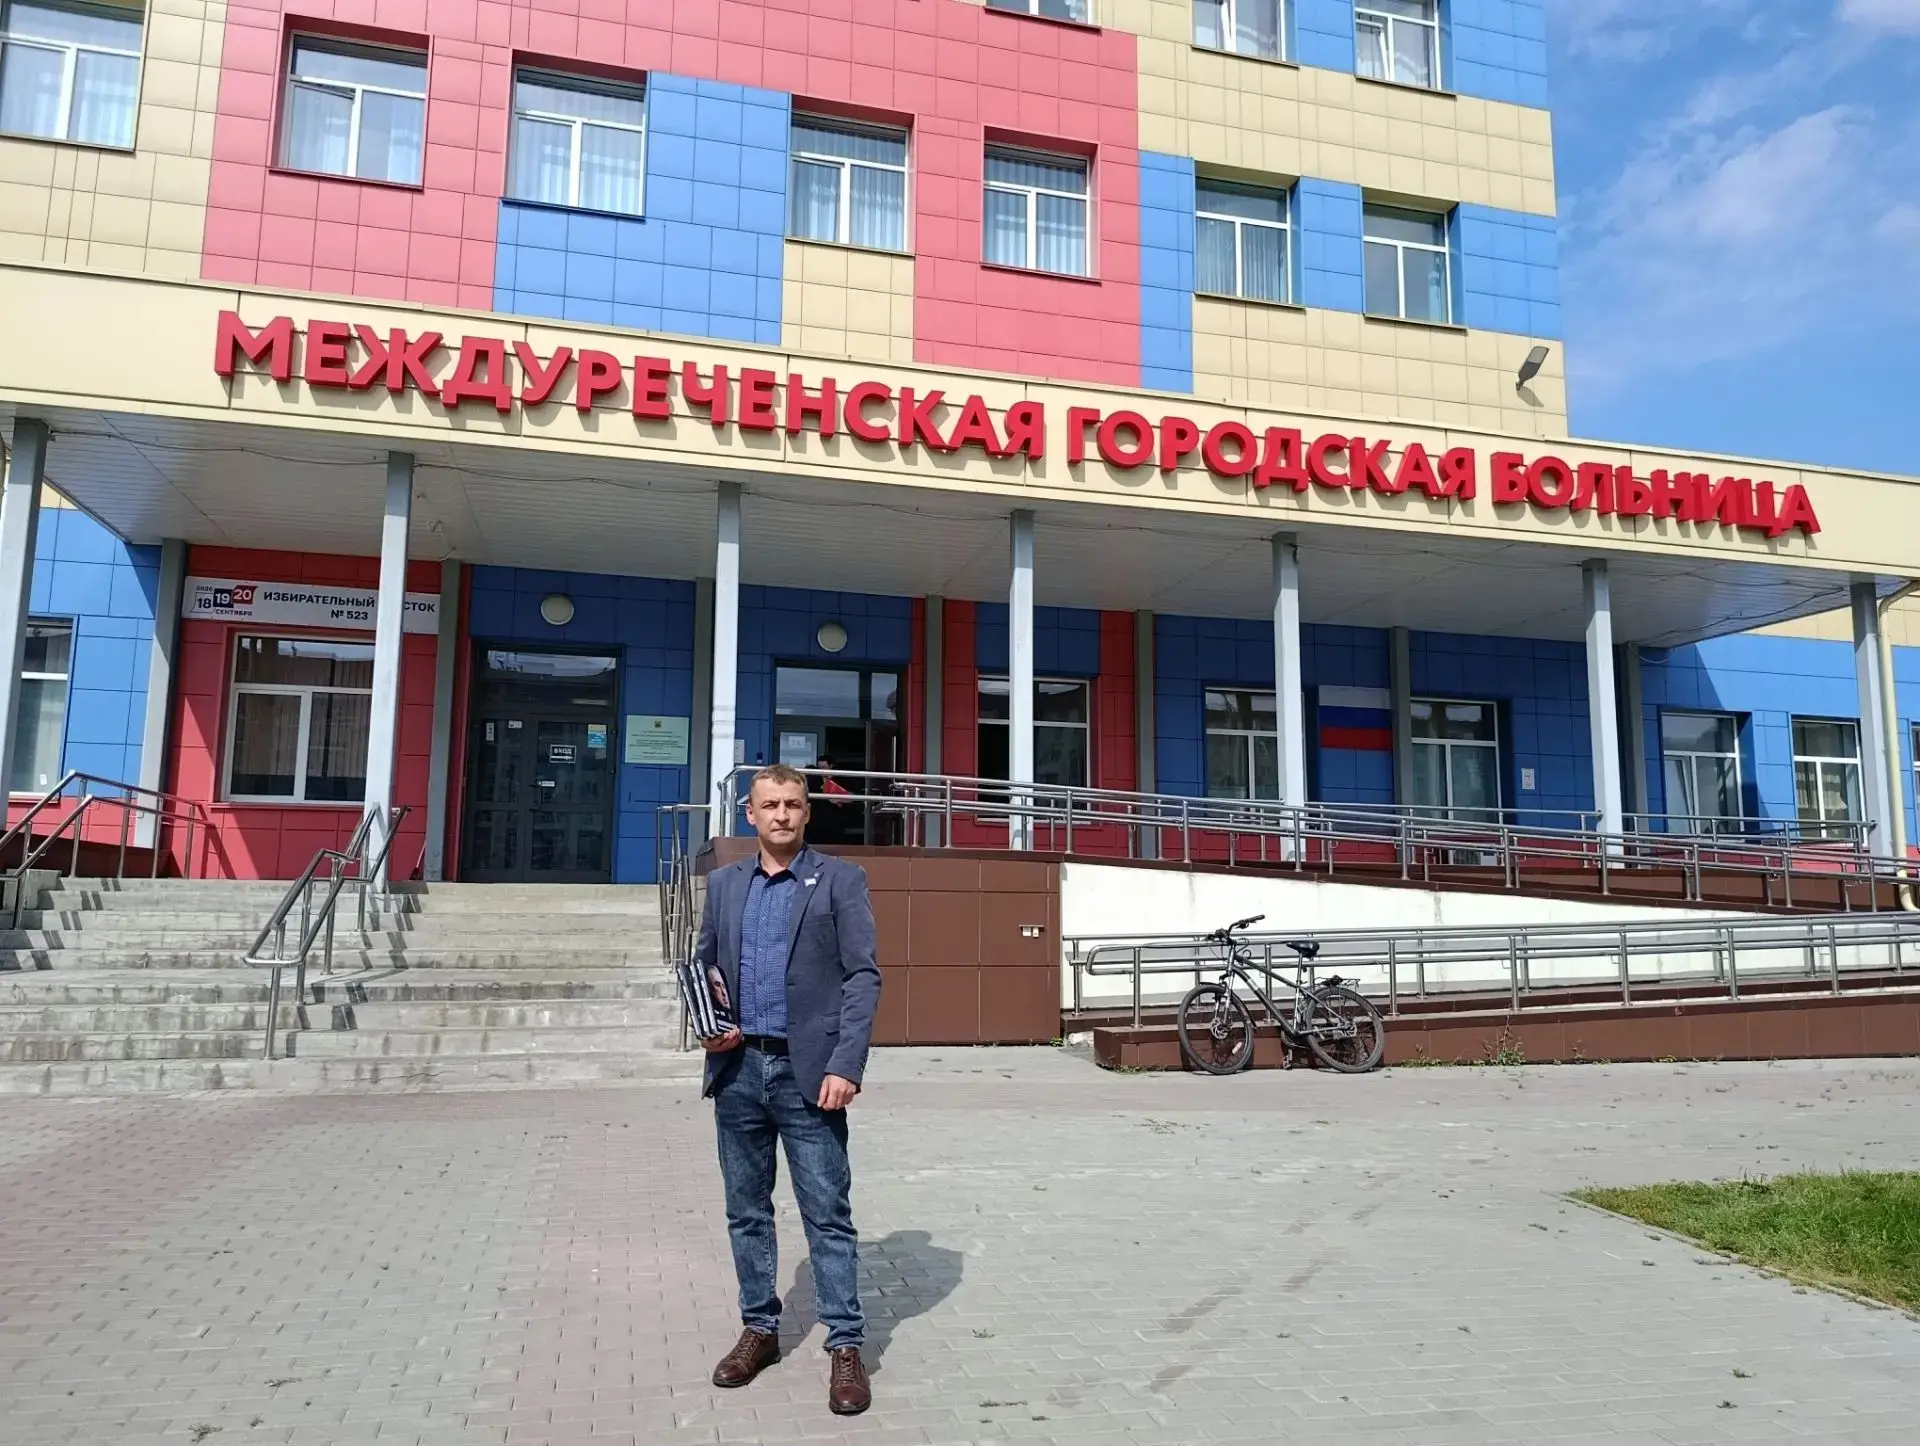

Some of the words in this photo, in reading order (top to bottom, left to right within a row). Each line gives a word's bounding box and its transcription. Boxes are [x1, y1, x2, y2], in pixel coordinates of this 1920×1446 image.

[215, 310, 1045, 460] МЕЖДУРЕЧЕНСКАЯ
[1067, 406, 1477, 501] ГОРОДСКАЯ
[1490, 451, 1821, 538] БОЛЬНИЦА
[197, 598, 212, 609] 18
[215, 592, 230, 604] 19
[233, 589, 252, 600] 20
[264, 591, 375, 607] ИЗБИРАТЕЛЬНЫЙ
[404, 601, 436, 612] СТОК
[215, 608, 253, 616] СЕНТЯБРЯ
[331, 609, 344, 619] №
[347, 610, 368, 620] 523
